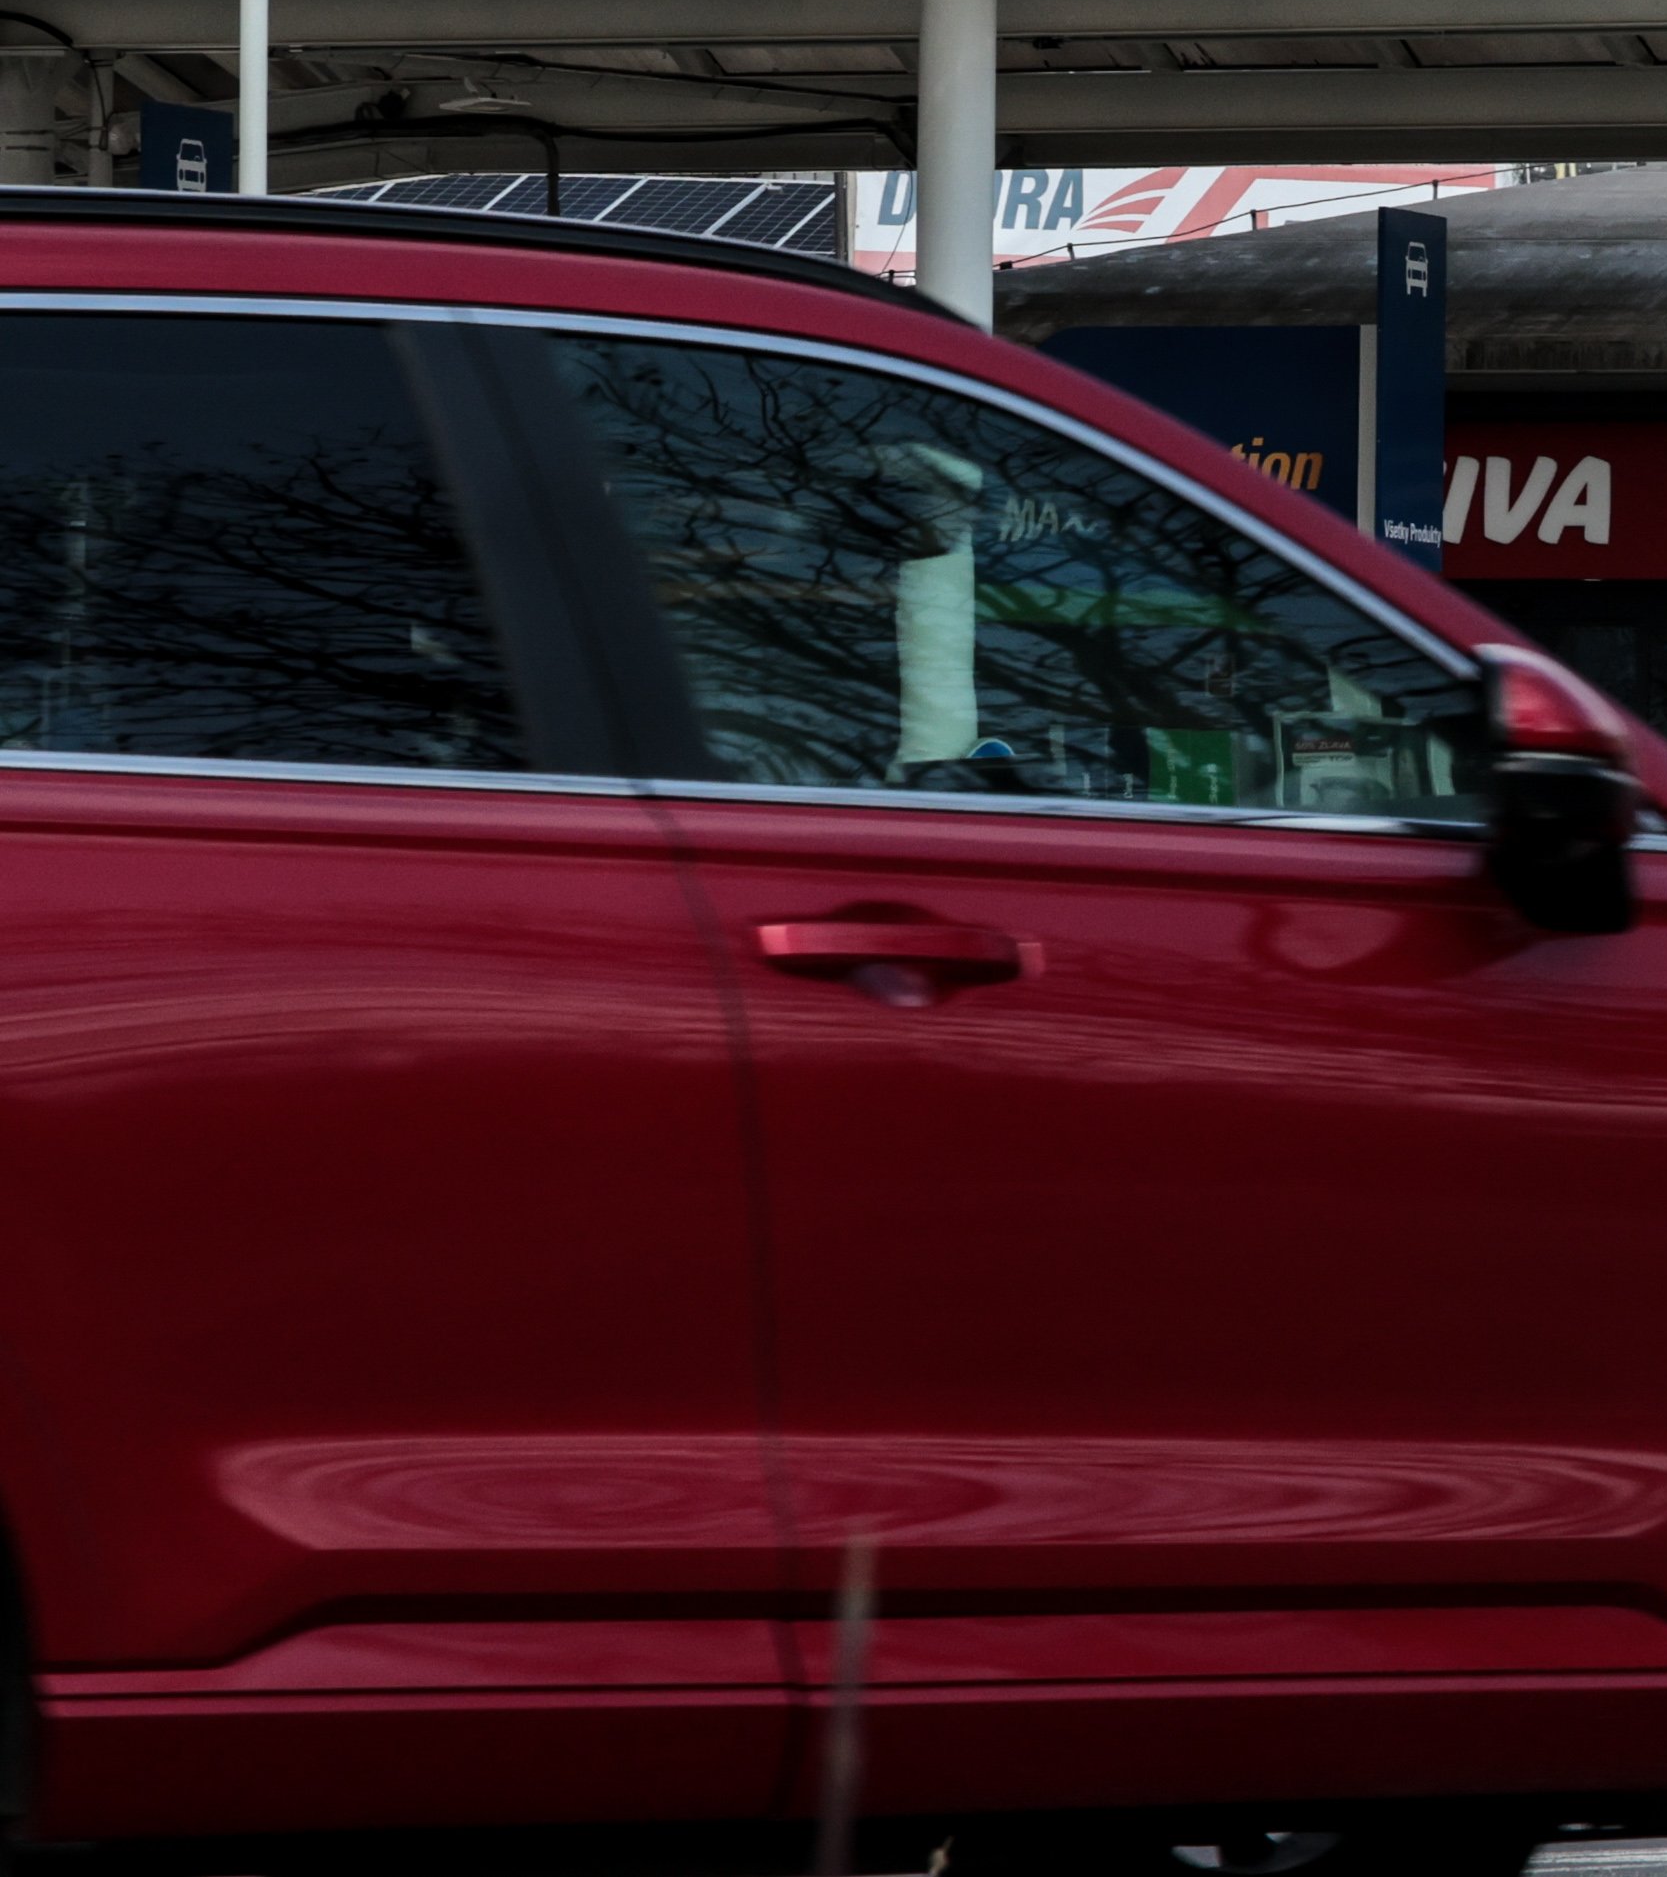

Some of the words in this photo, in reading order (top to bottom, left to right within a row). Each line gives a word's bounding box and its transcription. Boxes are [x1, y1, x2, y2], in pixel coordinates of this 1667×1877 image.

[877, 168, 1084, 231] DRA
[1441, 454, 1612, 546] IVA
[1410, 522, 1442, 549] Produkty
